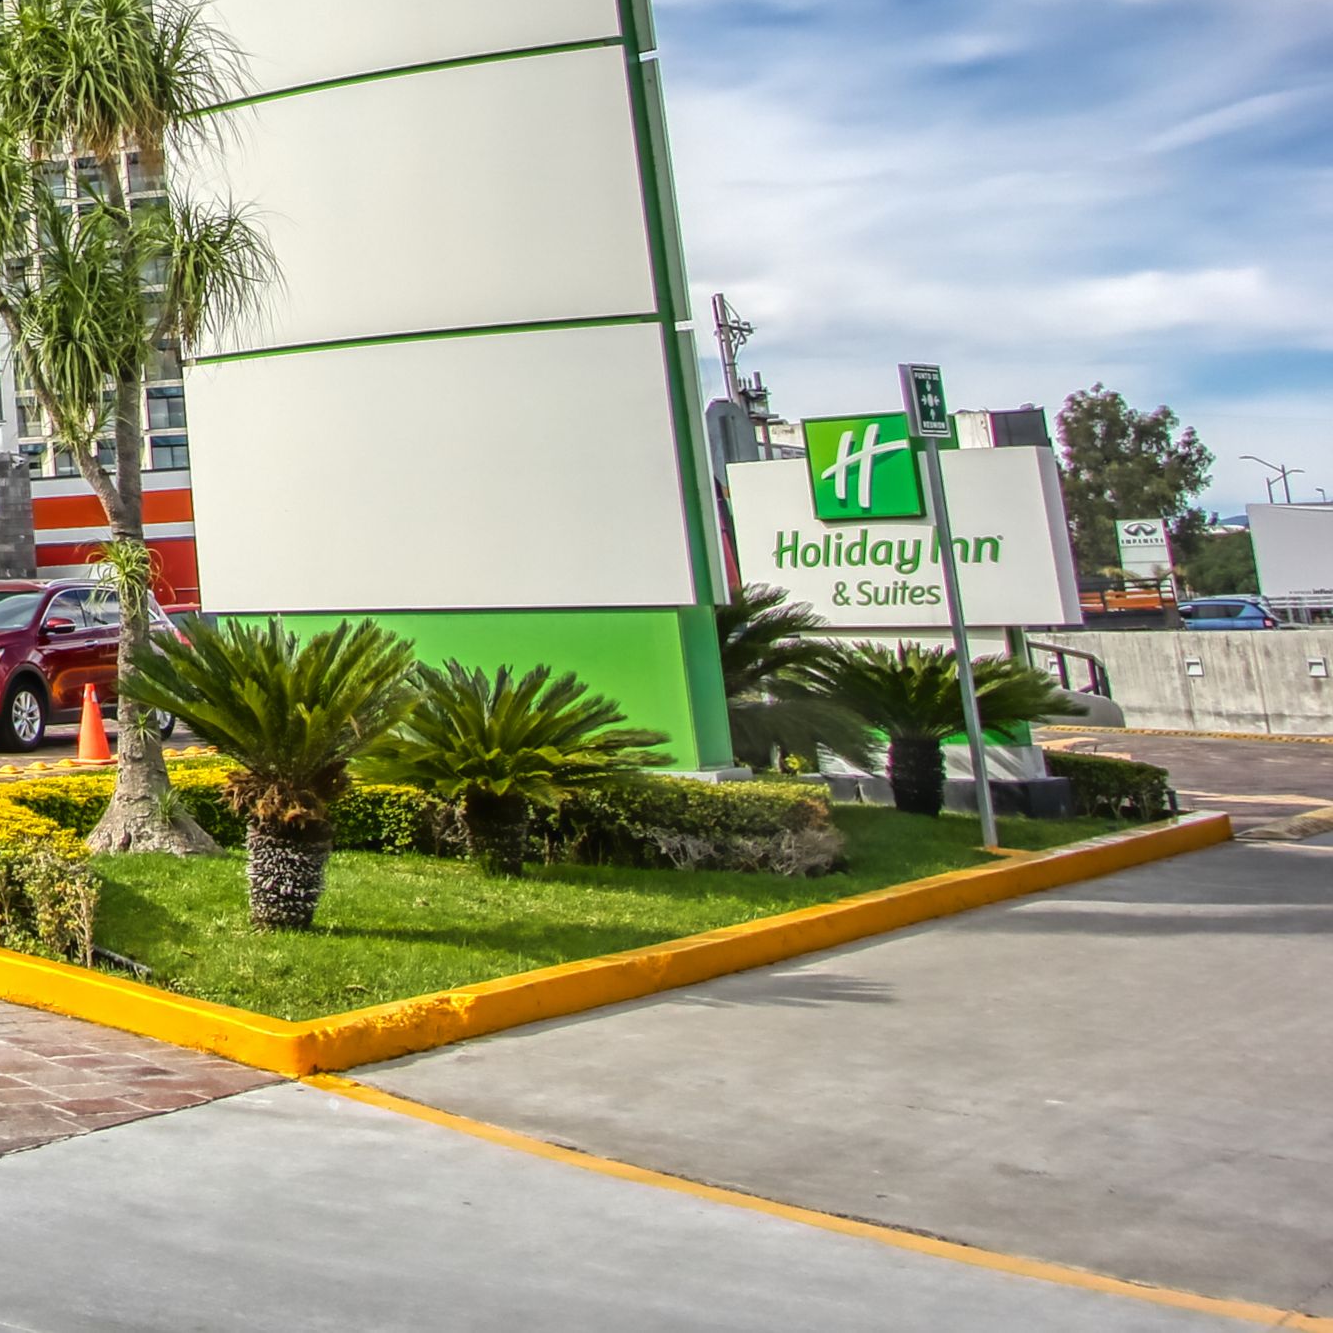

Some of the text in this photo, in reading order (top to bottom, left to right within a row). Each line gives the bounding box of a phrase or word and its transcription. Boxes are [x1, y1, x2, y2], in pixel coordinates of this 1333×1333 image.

[771, 526, 1001, 575] Holiday Inn
[833, 580, 941, 606] & Suites
